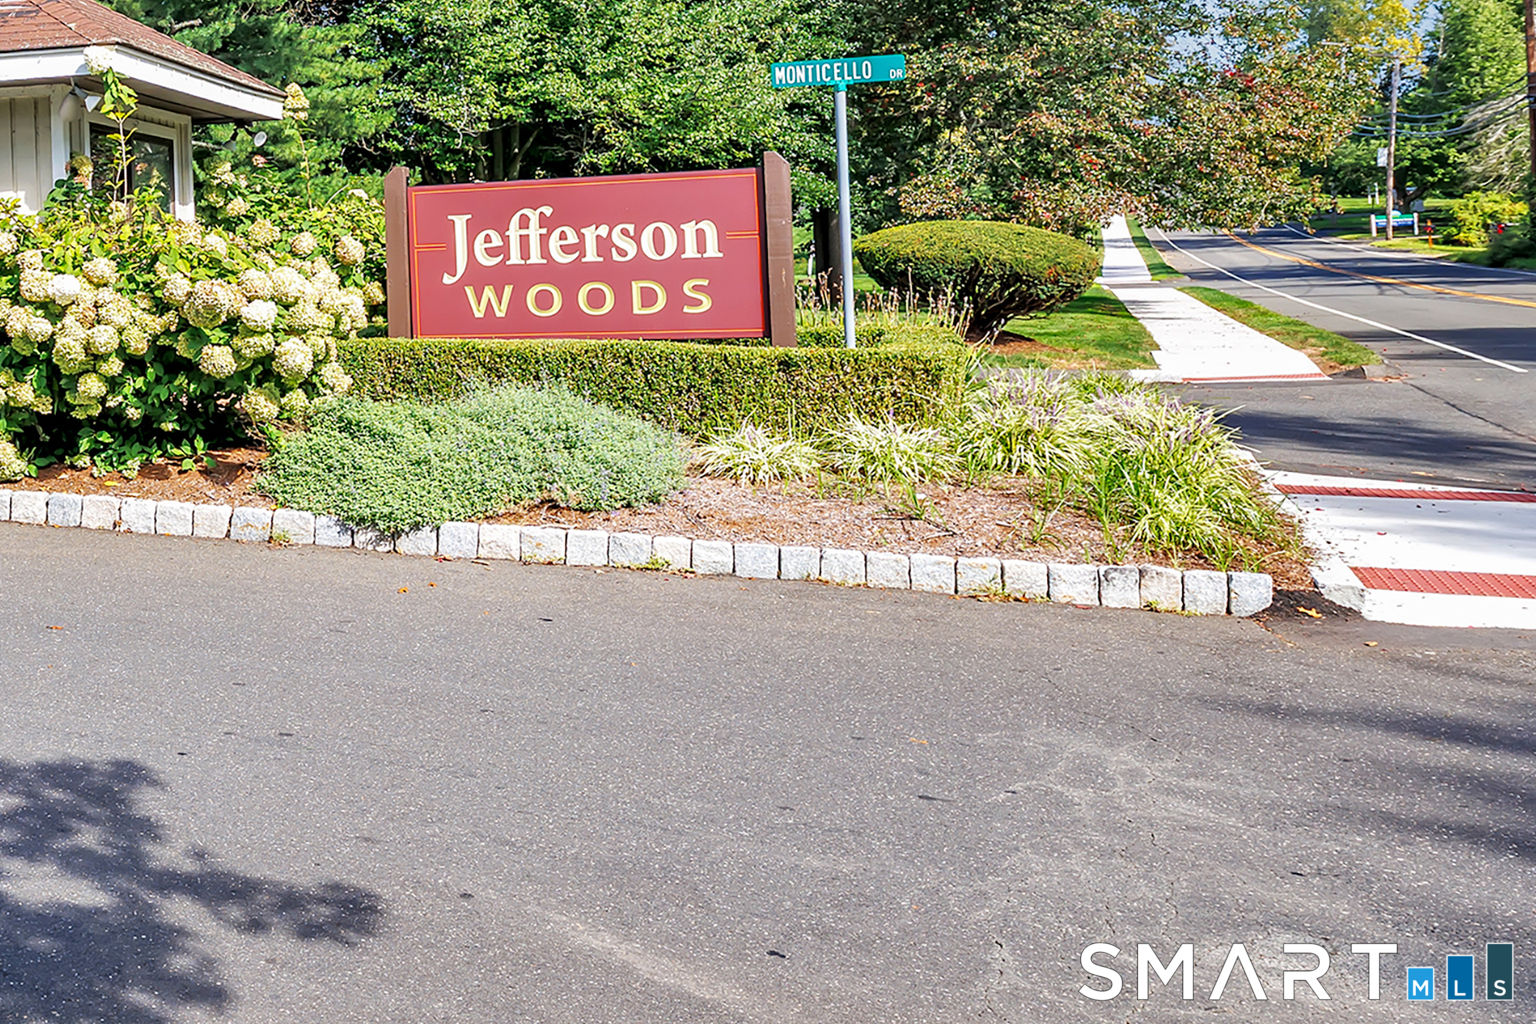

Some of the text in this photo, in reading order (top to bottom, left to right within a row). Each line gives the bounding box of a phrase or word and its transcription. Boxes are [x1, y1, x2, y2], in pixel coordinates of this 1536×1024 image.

[775, 60, 903, 85] MONTICELLO DR
[442, 205, 723, 285] Jefferson
[464, 278, 714, 319] WOODS
